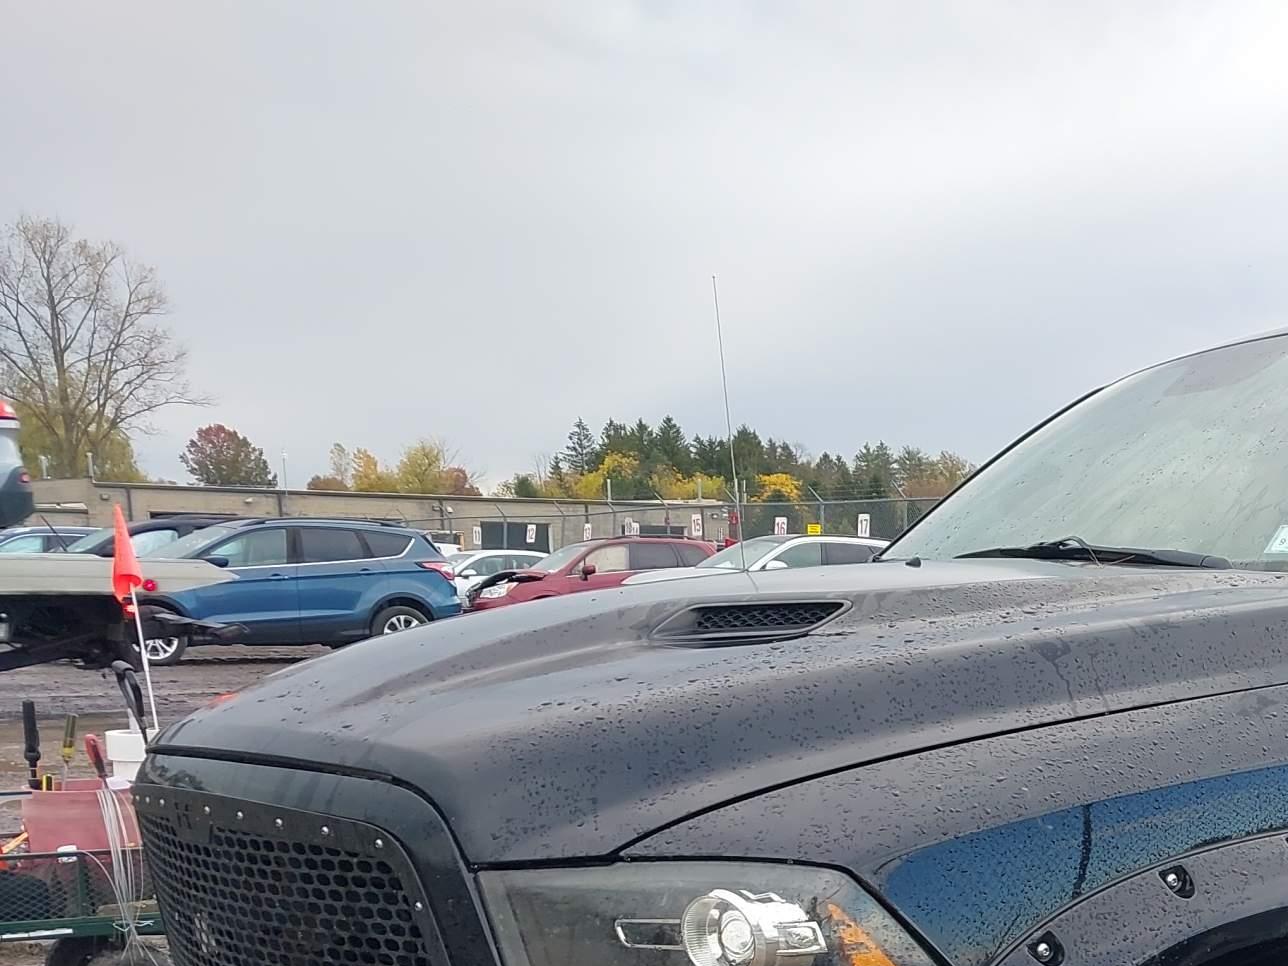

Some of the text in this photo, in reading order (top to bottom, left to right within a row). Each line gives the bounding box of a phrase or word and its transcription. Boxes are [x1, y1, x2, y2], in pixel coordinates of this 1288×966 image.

[692, 518, 701, 533] 15
[776, 521, 786, 535] 16
[860, 518, 868, 535] 17
[527, 527, 535, 540] 12
